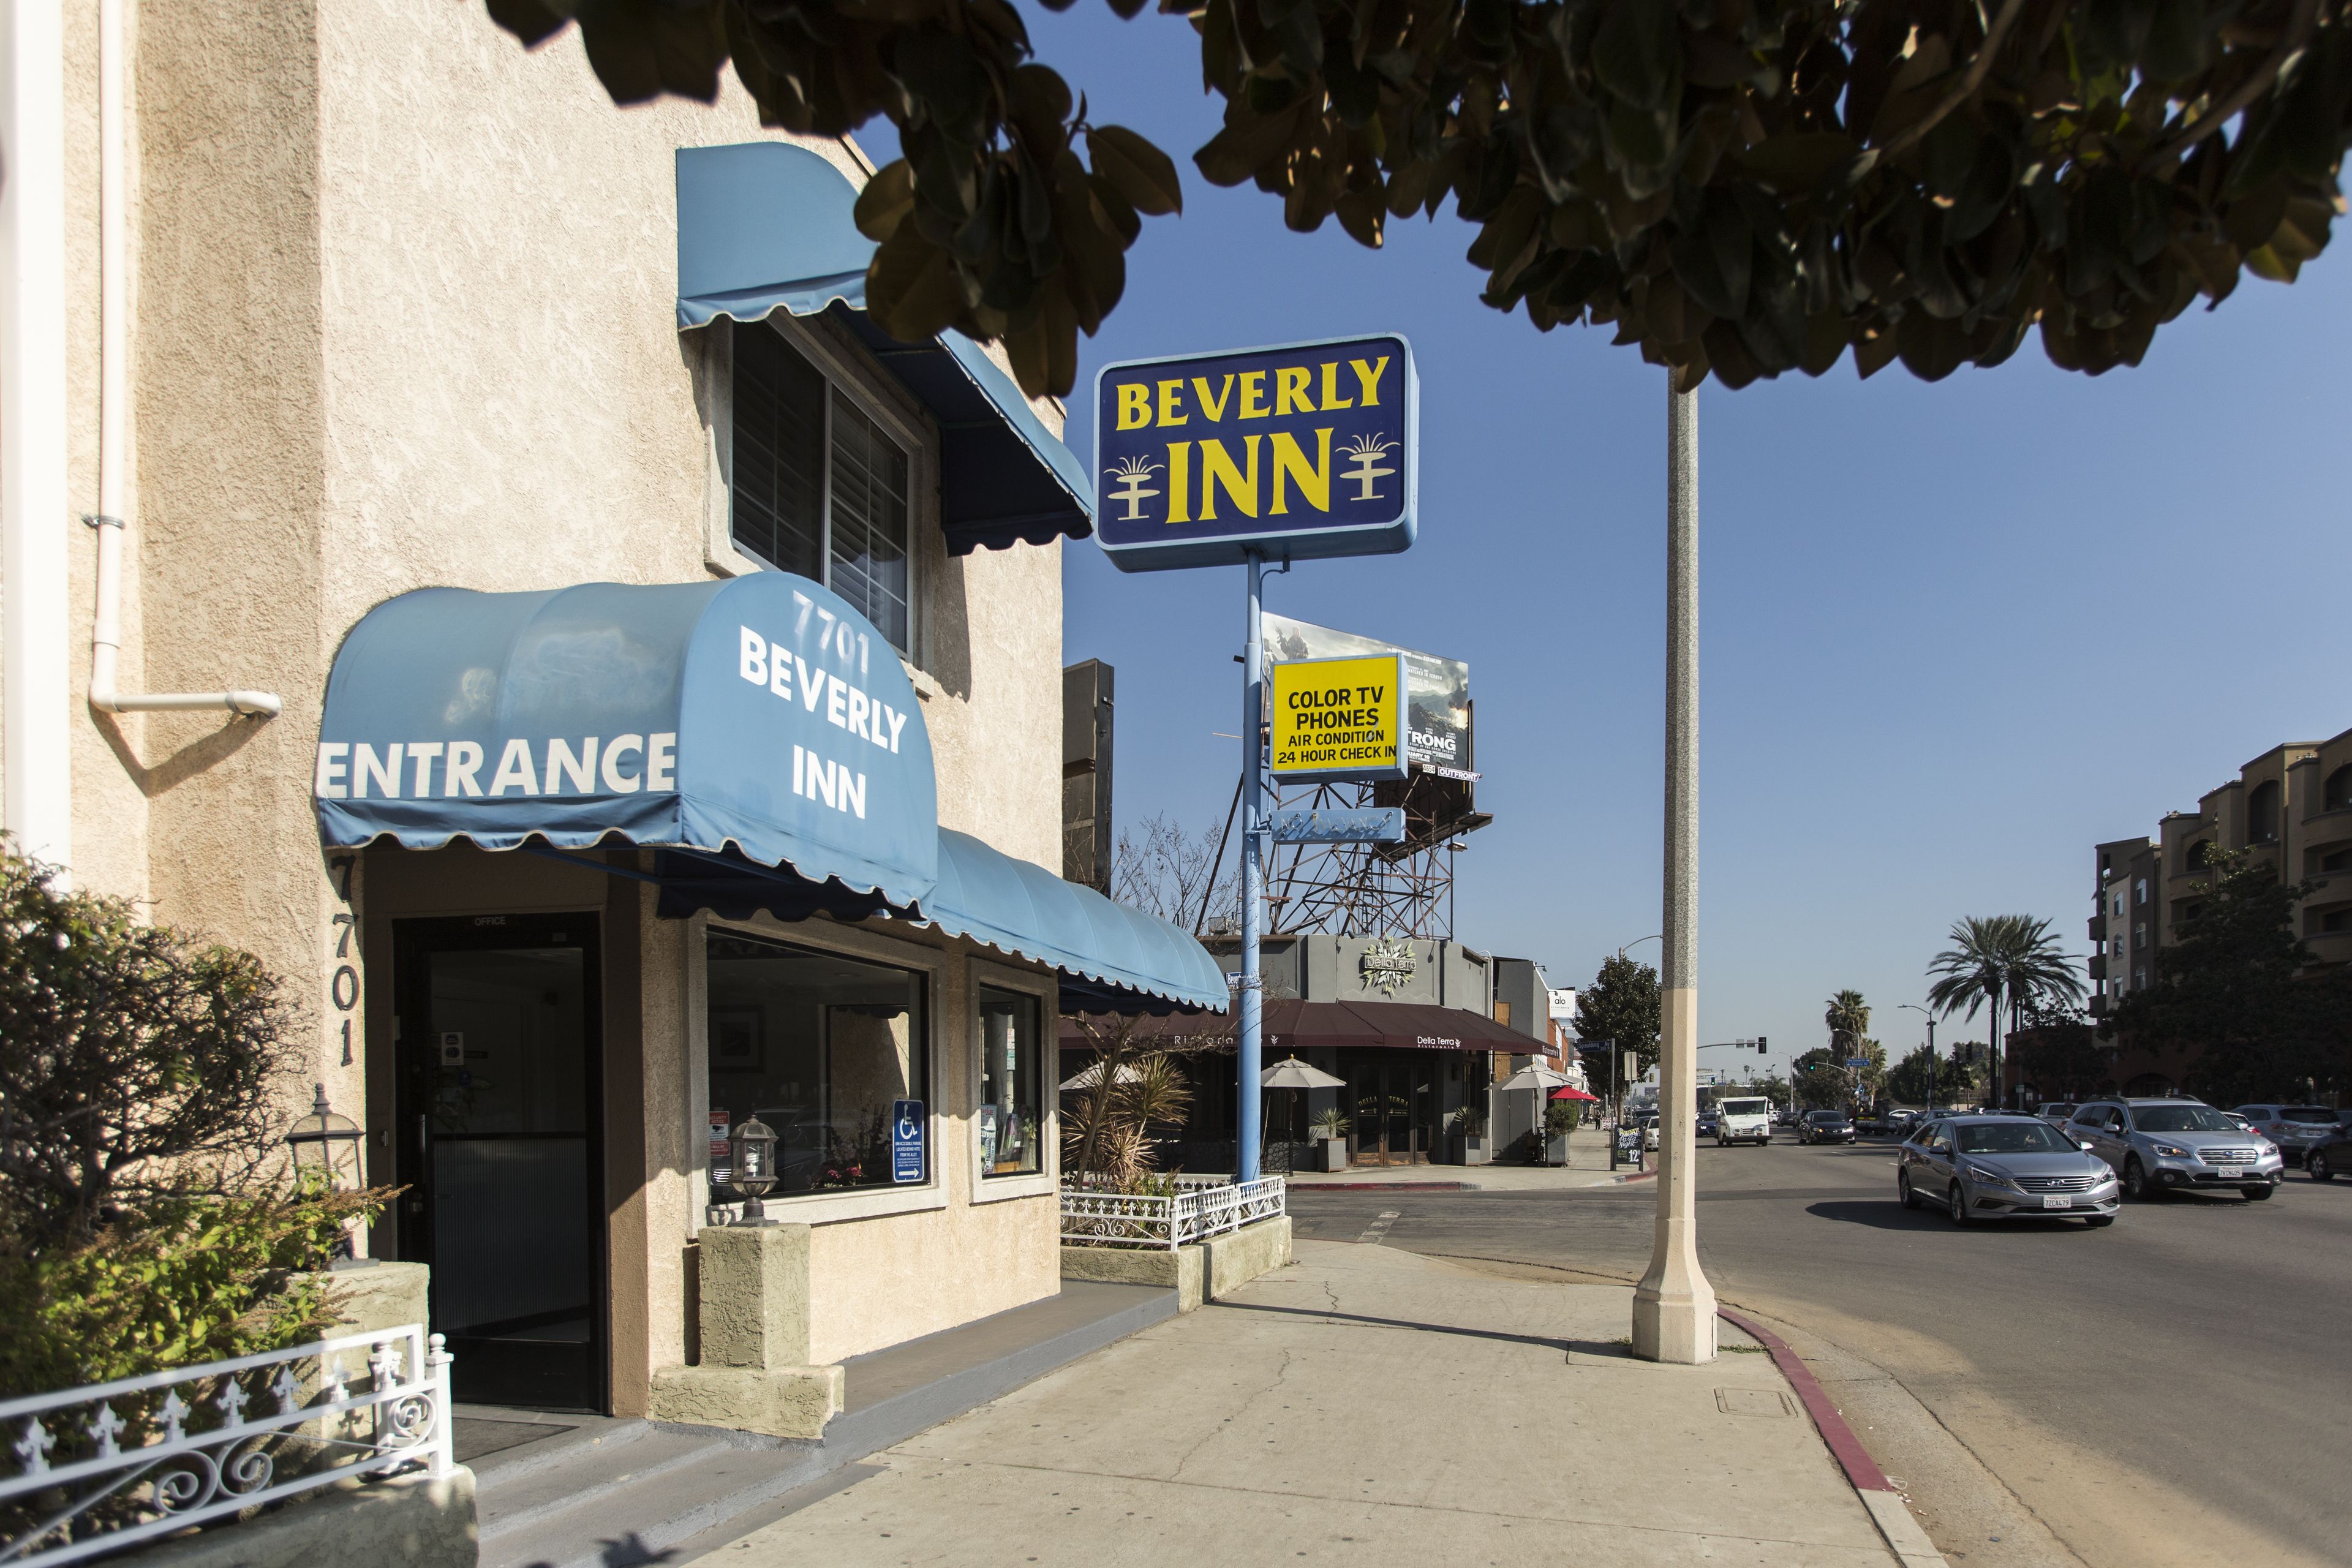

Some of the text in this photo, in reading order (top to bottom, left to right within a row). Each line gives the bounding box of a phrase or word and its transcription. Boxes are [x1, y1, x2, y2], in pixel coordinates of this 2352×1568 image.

[1116, 356, 1390, 431] BEVERLY
[1165, 428, 1334, 524] INN
[793, 590, 869, 673] 7701
[739, 625, 907, 755] BEVERLY
[1288, 686, 1384, 709] COLOR TV
[1297, 708, 1379, 730] PHONES
[1288, 729, 1384, 747] AIR CONDITION
[1278, 751, 1296, 764] 24
[1301, 749, 1336, 762] HOUR
[1340, 746, 1381, 760] CHECK
[1385, 745, 1396, 758] IN
[317, 733, 677, 799] ENTRANCE
[1439, 769, 1477, 781] OUTFRONT
[792, 744, 867, 819] INN
[475, 916, 506, 926] OFFICE
[331, 855, 360, 1067] 7701
[1368, 956, 1392, 967] Della
[1227, 974, 1241, 984] Bever
[1555, 996, 1566, 1005] alo
[1358, 1096, 1408, 1106] DELLA TERRA
[1629, 1150, 1639, 1162] 12
